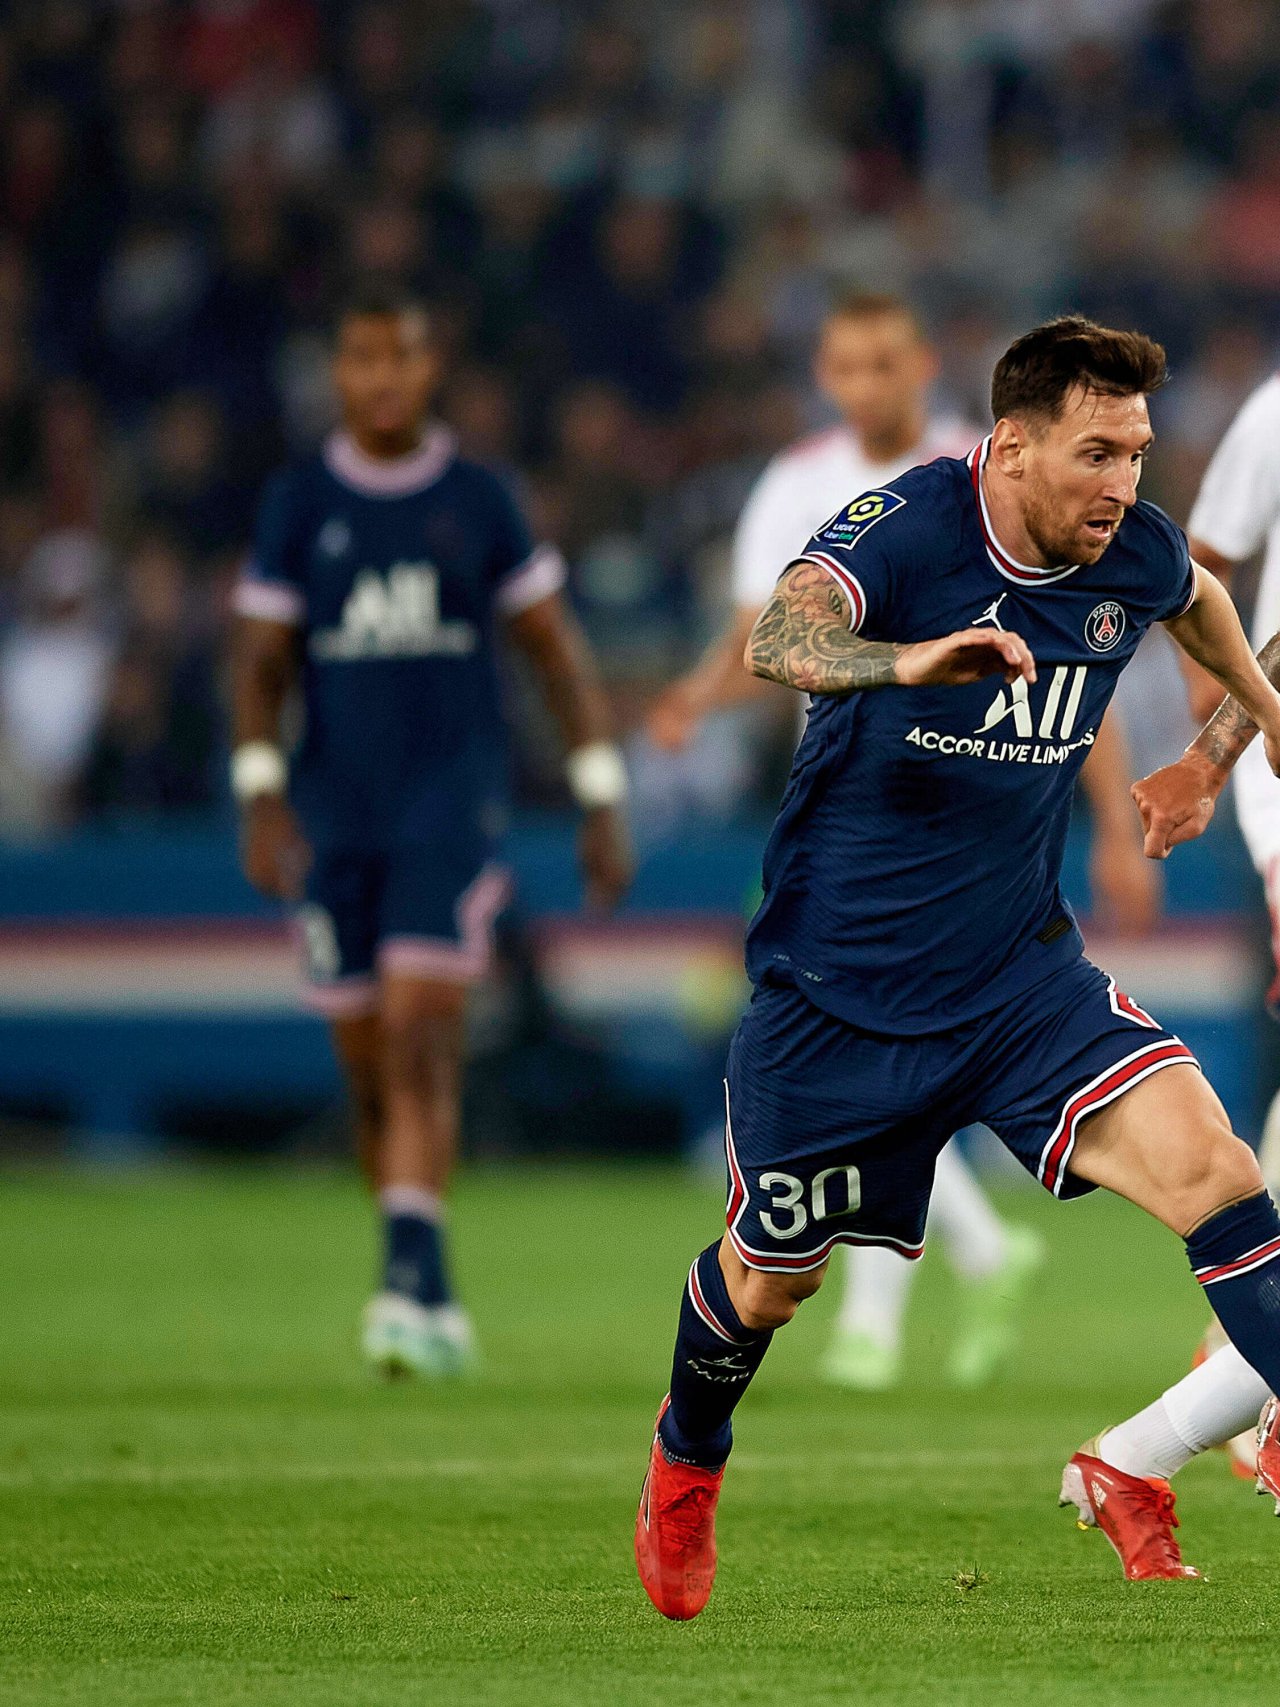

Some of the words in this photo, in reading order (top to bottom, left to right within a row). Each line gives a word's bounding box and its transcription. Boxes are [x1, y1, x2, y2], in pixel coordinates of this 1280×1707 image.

[1092, 604, 1119, 619] PARIS
[905, 726, 986, 757] ACCOR
[987, 740, 1029, 762] LIVE
[758, 1164, 862, 1240] 30
